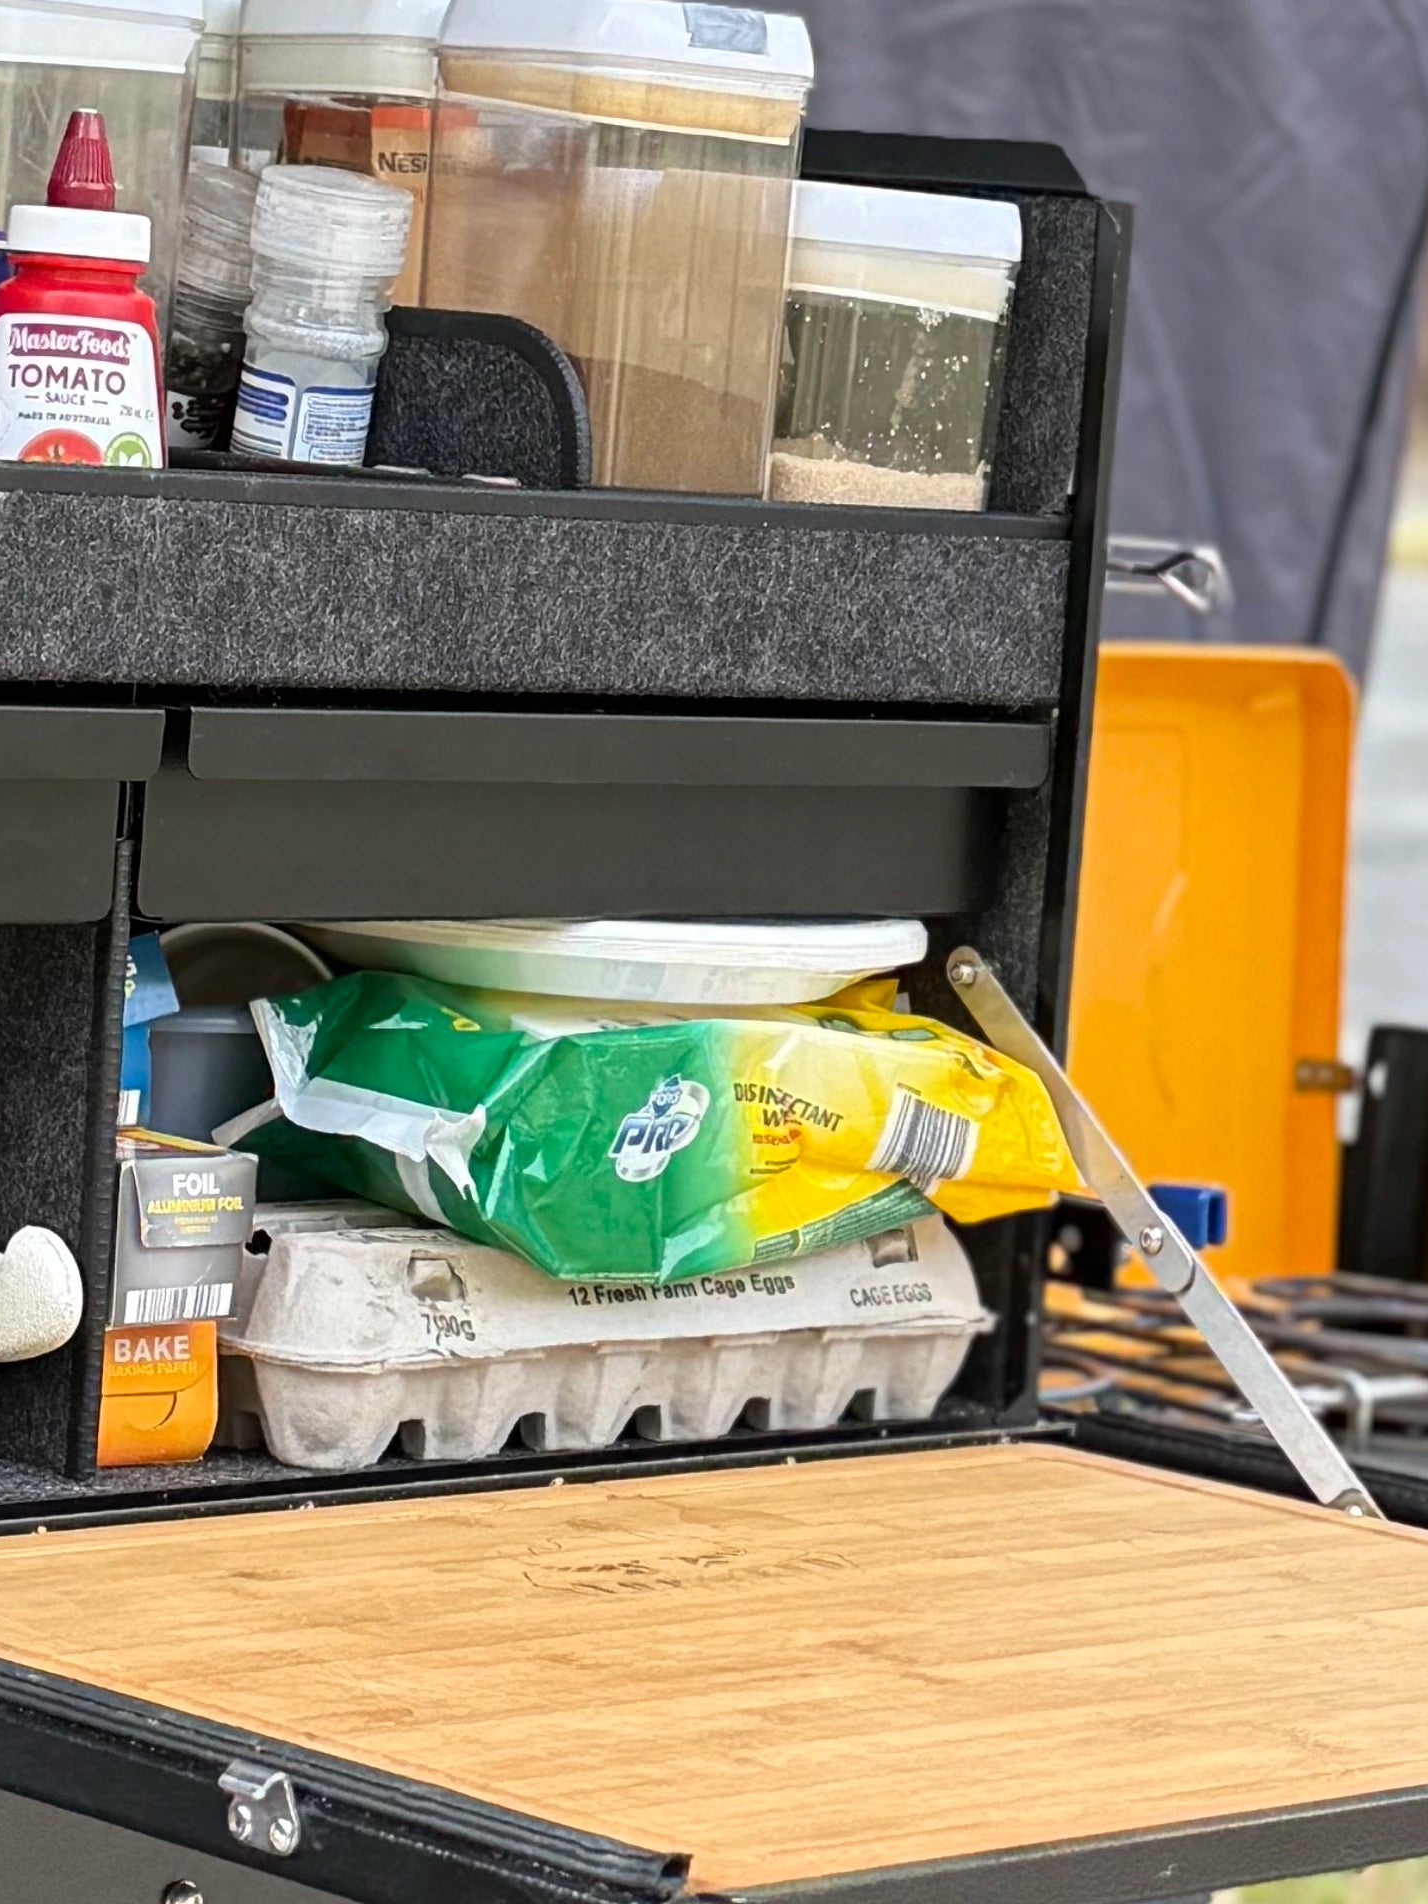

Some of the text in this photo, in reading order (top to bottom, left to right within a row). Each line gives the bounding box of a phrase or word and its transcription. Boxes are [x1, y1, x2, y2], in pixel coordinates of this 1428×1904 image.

[7, 325, 135, 359] MasterFoods
[8, 363, 126, 396] TOMATO
[45, 391, 86, 407] SAUCE
[172, 1172, 221, 1197] FOIL
[217, 1196, 244, 1212] FOIL
[569, 1272, 796, 1306] 12 Fresh Farm Cage Eggs
[849, 1282, 933, 1307] CAGE EGGS
[113, 1335, 191, 1364] BAKE
